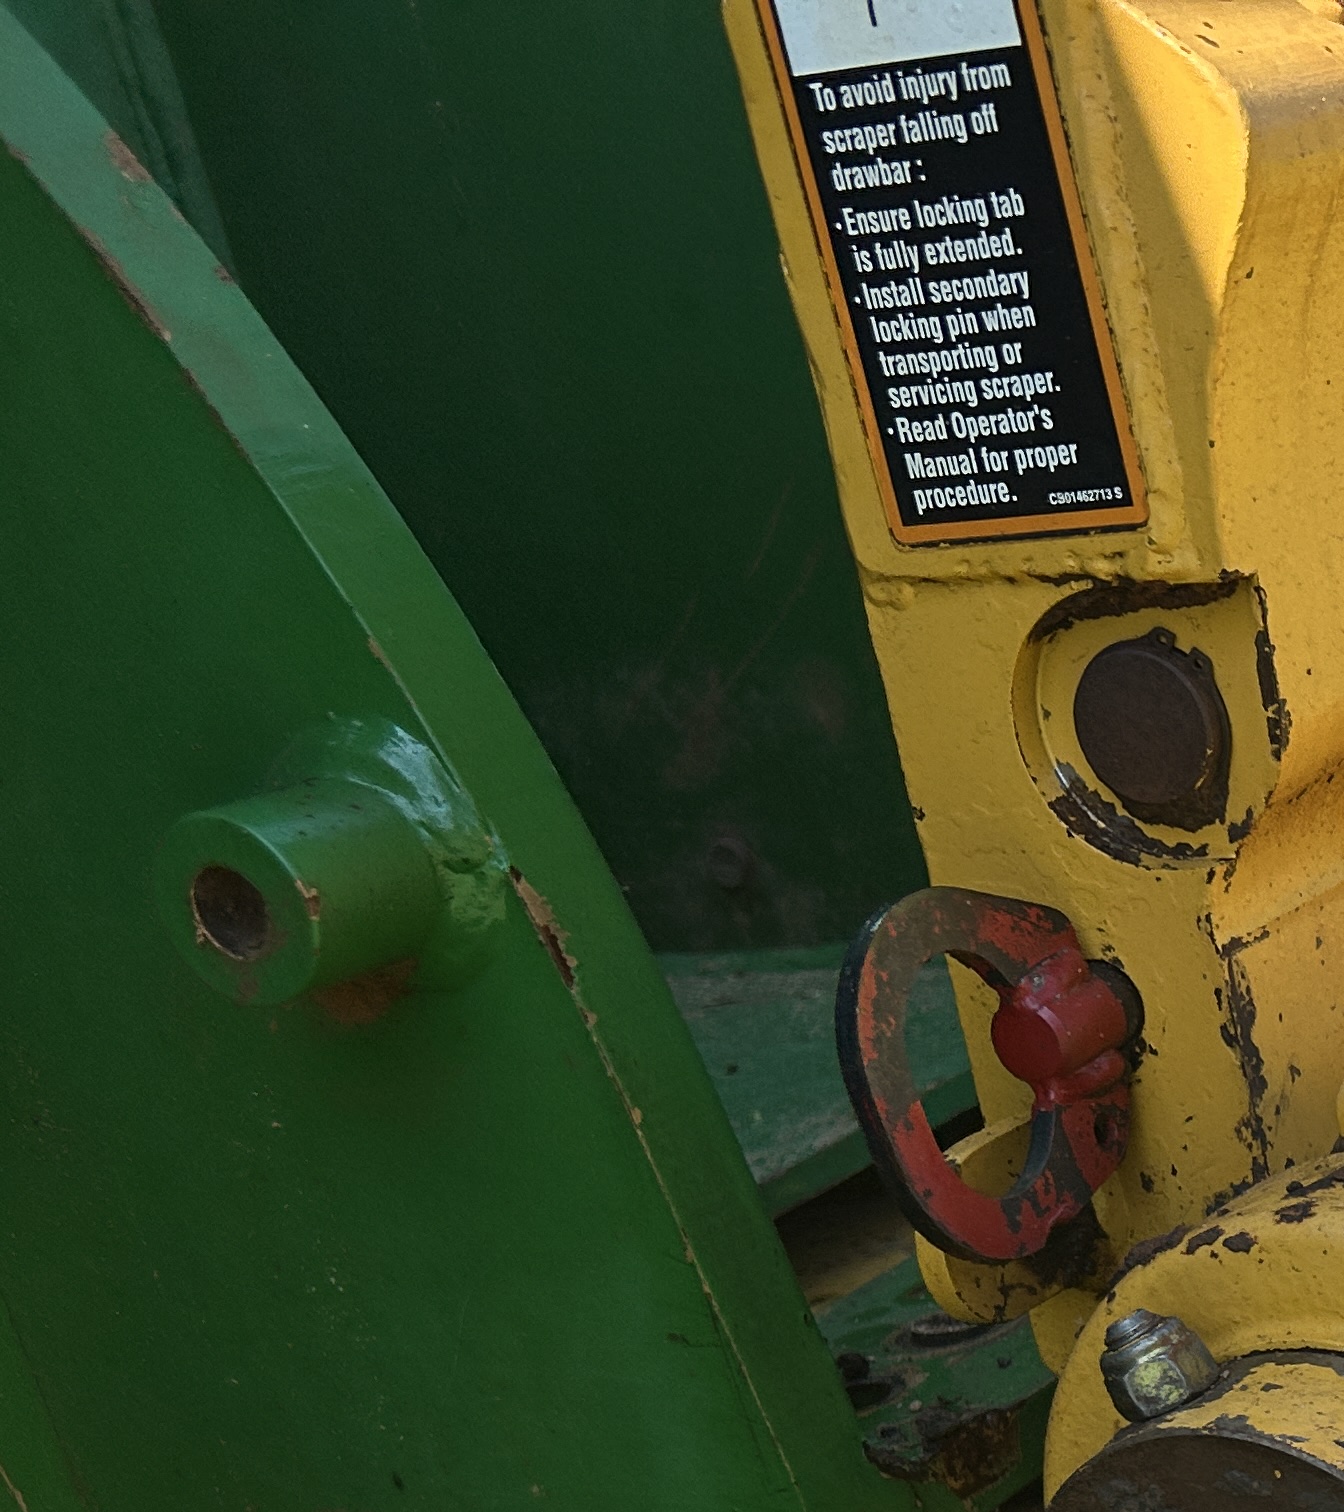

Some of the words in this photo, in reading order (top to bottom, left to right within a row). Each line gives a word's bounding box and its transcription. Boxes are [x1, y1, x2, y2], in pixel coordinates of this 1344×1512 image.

[808, 82, 837, 112] To
[839, 72, 897, 109] avoid
[896, 68, 958, 105] injury
[960, 61, 1012, 92] from
[822, 123, 897, 156] scraper
[899, 109, 969, 144] falling
[970, 102, 999, 135] off
[841, 207, 912, 236] Ensure
[913, 194, 990, 229] locking
[989, 187, 1025, 219] tab
[851, 244, 874, 273] is
[874, 239, 920, 274] fully
[923, 227, 1023, 266] extended.
[861, 276, 926, 310] Install
[928, 268, 1030, 304] secondary
[869, 312, 944, 344] locking
[945, 307, 980, 343] pin
[980, 302, 1037, 332] when
[878, 341, 1000, 379] transporting
[1001, 342, 1023, 365] or
[887, 376, 979, 409] servicing
[980, 371, 1061, 402] scraper.
[895, 413, 949, 444] Read
[950, 403, 1054, 444] Operator's
[903, 447, 979, 480] Manual
[980, 446, 1009, 473] for
[1013, 443, 1078, 476] proper
[913, 479, 1018, 516] procedure.
